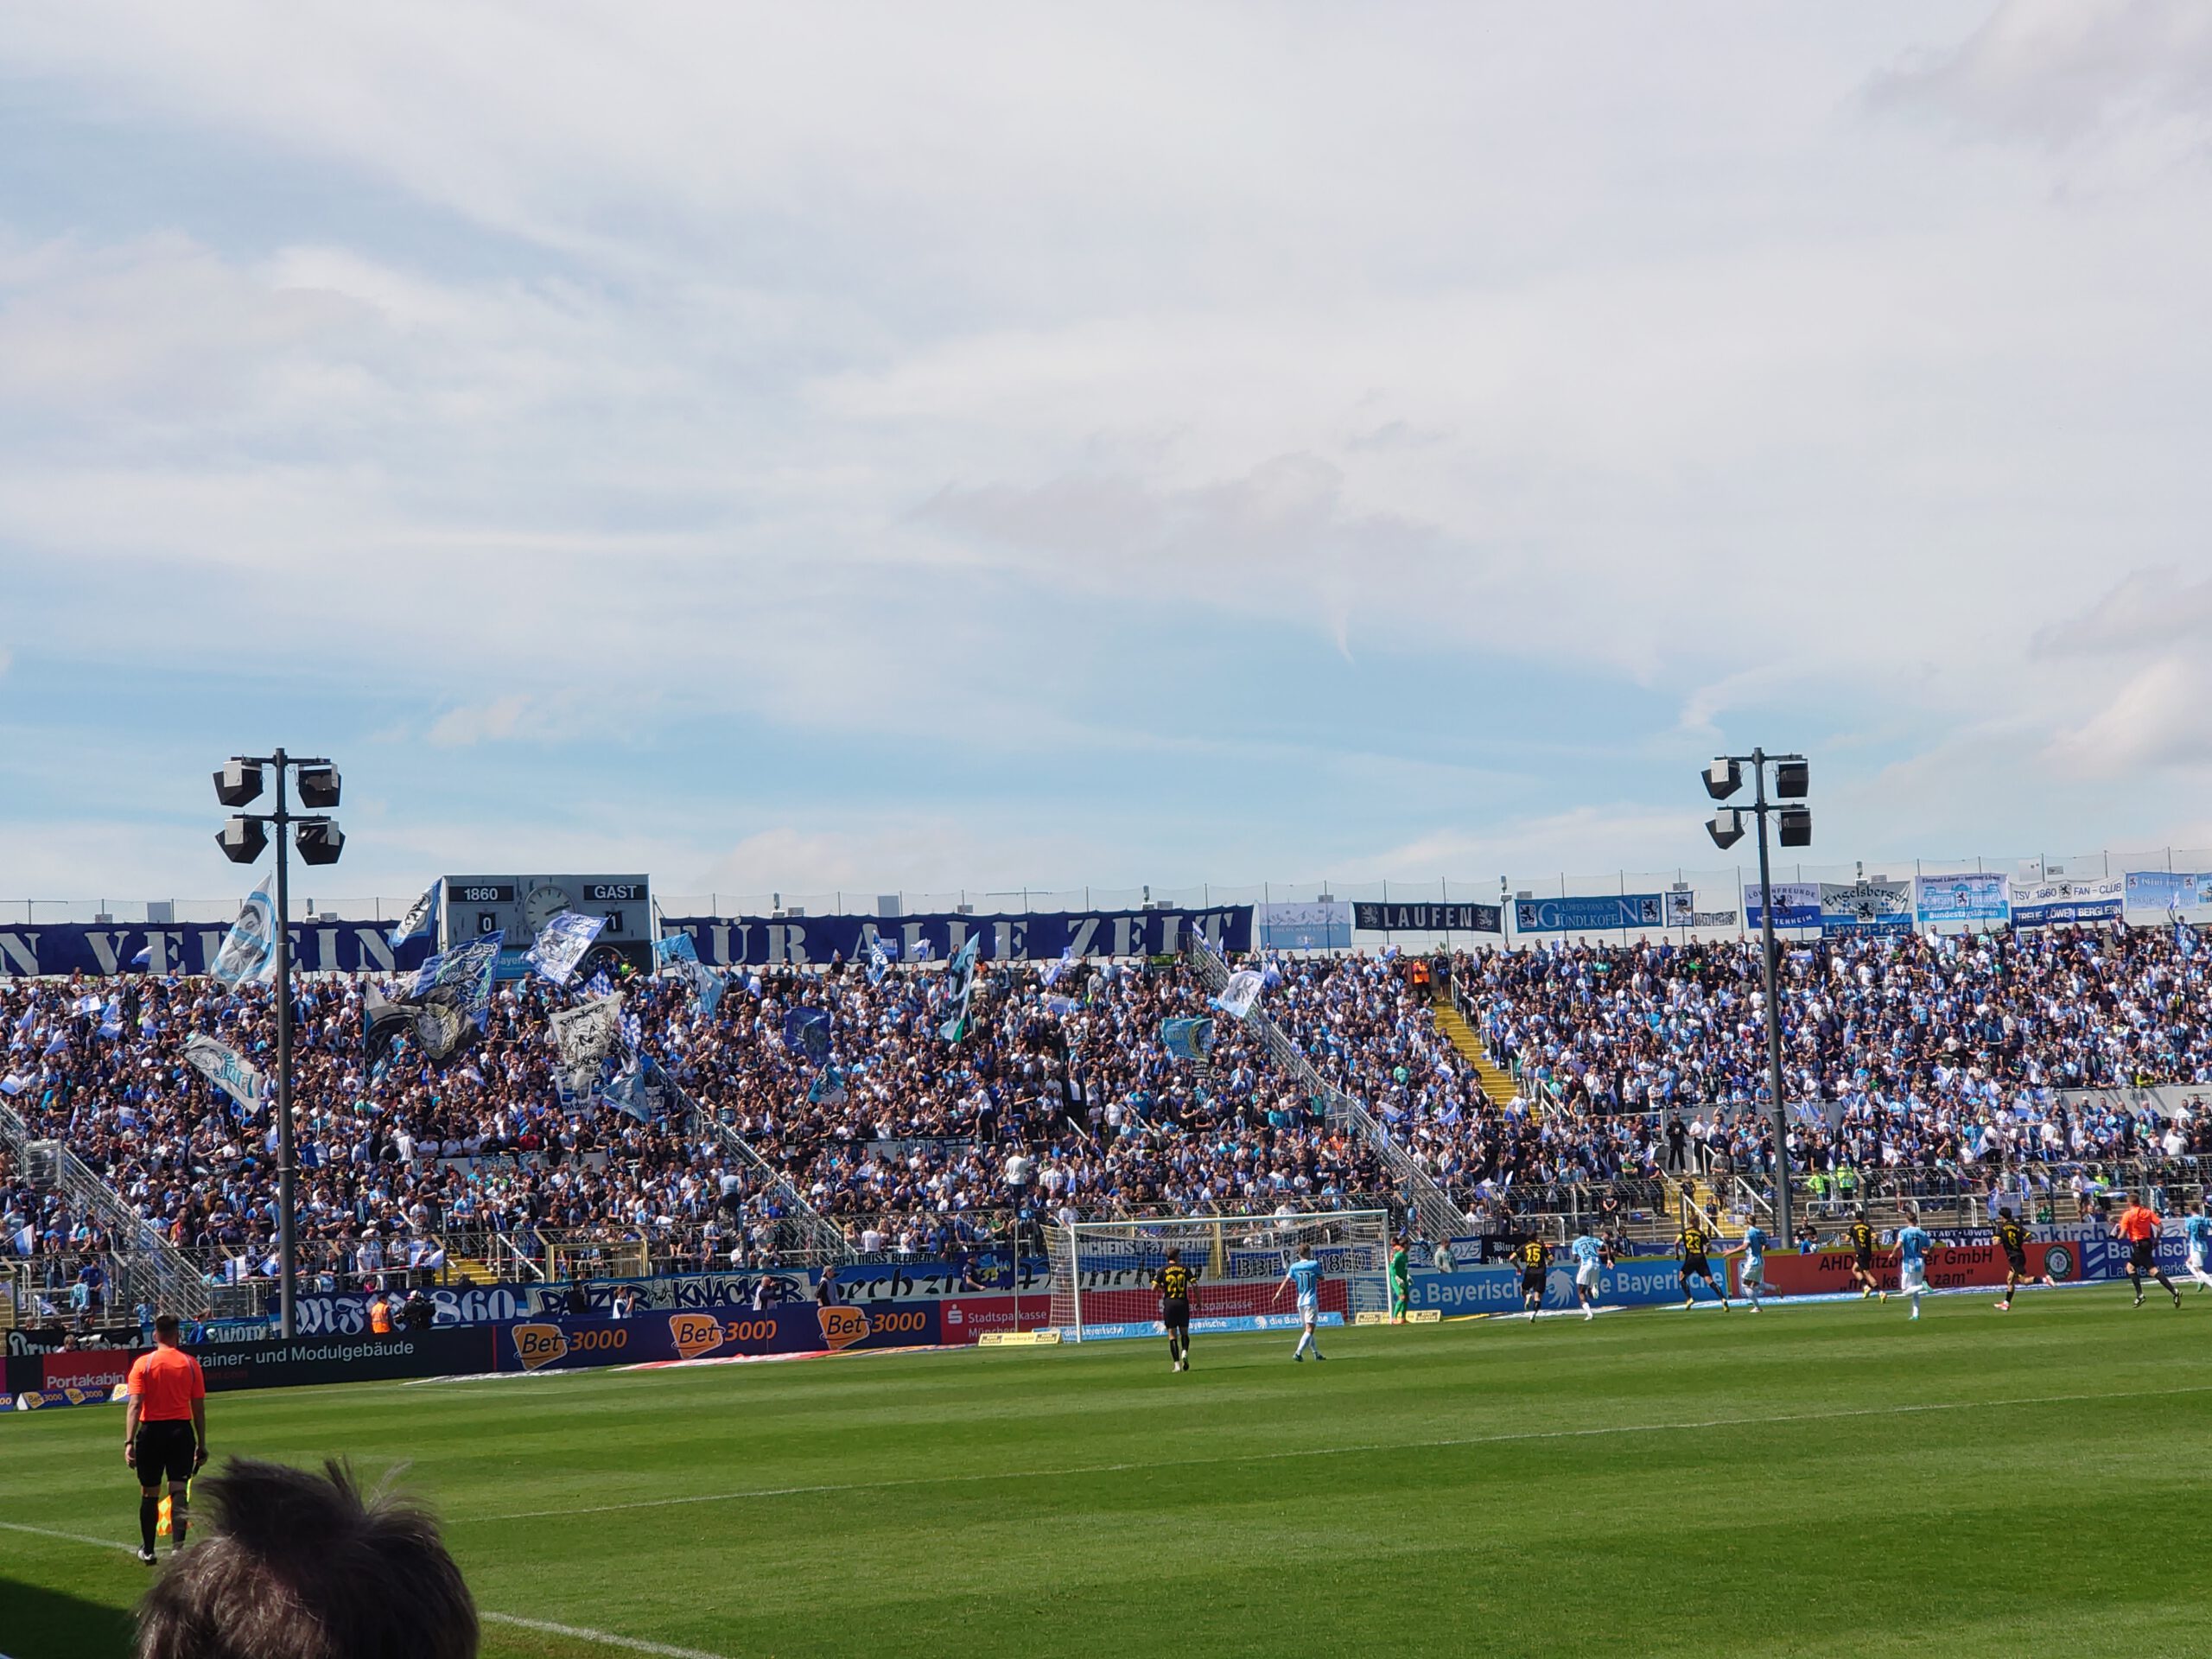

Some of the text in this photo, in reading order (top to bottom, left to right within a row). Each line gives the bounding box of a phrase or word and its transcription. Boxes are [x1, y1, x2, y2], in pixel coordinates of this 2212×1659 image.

[464, 887, 499, 901] 1860
[594, 885, 638, 899] GAST
[1748, 887, 1816, 899] LÖNFREUNDE
[2013, 890, 2031, 900] TSV
[2036, 888, 2056, 899] 1860
[2074, 887, 2090, 896] FAN
[2099, 882, 2122, 894] CLUB
[1383, 906, 1472, 928] LAUFEN
[1757, 913, 1813, 925] HTENHEIM
[2016, 905, 2121, 922] TREUE LÖWEN BERGLERN
[482, 917, 492, 931] 0
[611, 915, 617, 931] 1
[84, 929, 396, 976] VEIN
[847, 920, 1028, 963] ALLE
[1067, 912, 1234, 958] ZEIT
[1858, 1229, 1866, 1243] 5
[2007, 1230, 2017, 1245] 6
[2030, 1224, 2108, 1242] erkirch
[1077, 1240, 1135, 1255] NCHENS
[1452, 1243, 1481, 1258] OYS
[1492, 1241, 1516, 1253] Blue
[1526, 1247, 1541, 1262] 15
[2108, 1240, 2189, 1259] Barisc
[832, 1252, 934, 1268] 50+1 MUSS BLEIBEN!
[1819, 1248, 1993, 1272] AHD itzber GmbH
[1166, 1274, 1185, 1293] 20
[1299, 1272, 1311, 1288] 11
[1617, 1268, 1724, 1295] Bayerice
[536, 1274, 810, 1314] PAZR KNACKR
[1427, 1277, 1524, 1306] Bayerisch
[430, 1289, 518, 1324] 860
[1189, 1300, 1253, 1313] atsparkasse
[828, 1312, 926, 1336] Bet 3000
[968, 1309, 1047, 1324] Stadtspakasse
[1189, 1319, 1228, 1329] ayerische
[1284, 1314, 1329, 1324] Bayhe
[680, 1319, 777, 1344] Bet 3000
[522, 1328, 627, 1354] Bet 3000
[196, 1340, 415, 1368] tainer- und Modulgebäude
[47, 1371, 125, 1389] Portakabin
[0, 1396, 12, 1405] 00
[42, 1393, 63, 1402] 3000
[85, 1389, 104, 1398] 3000
